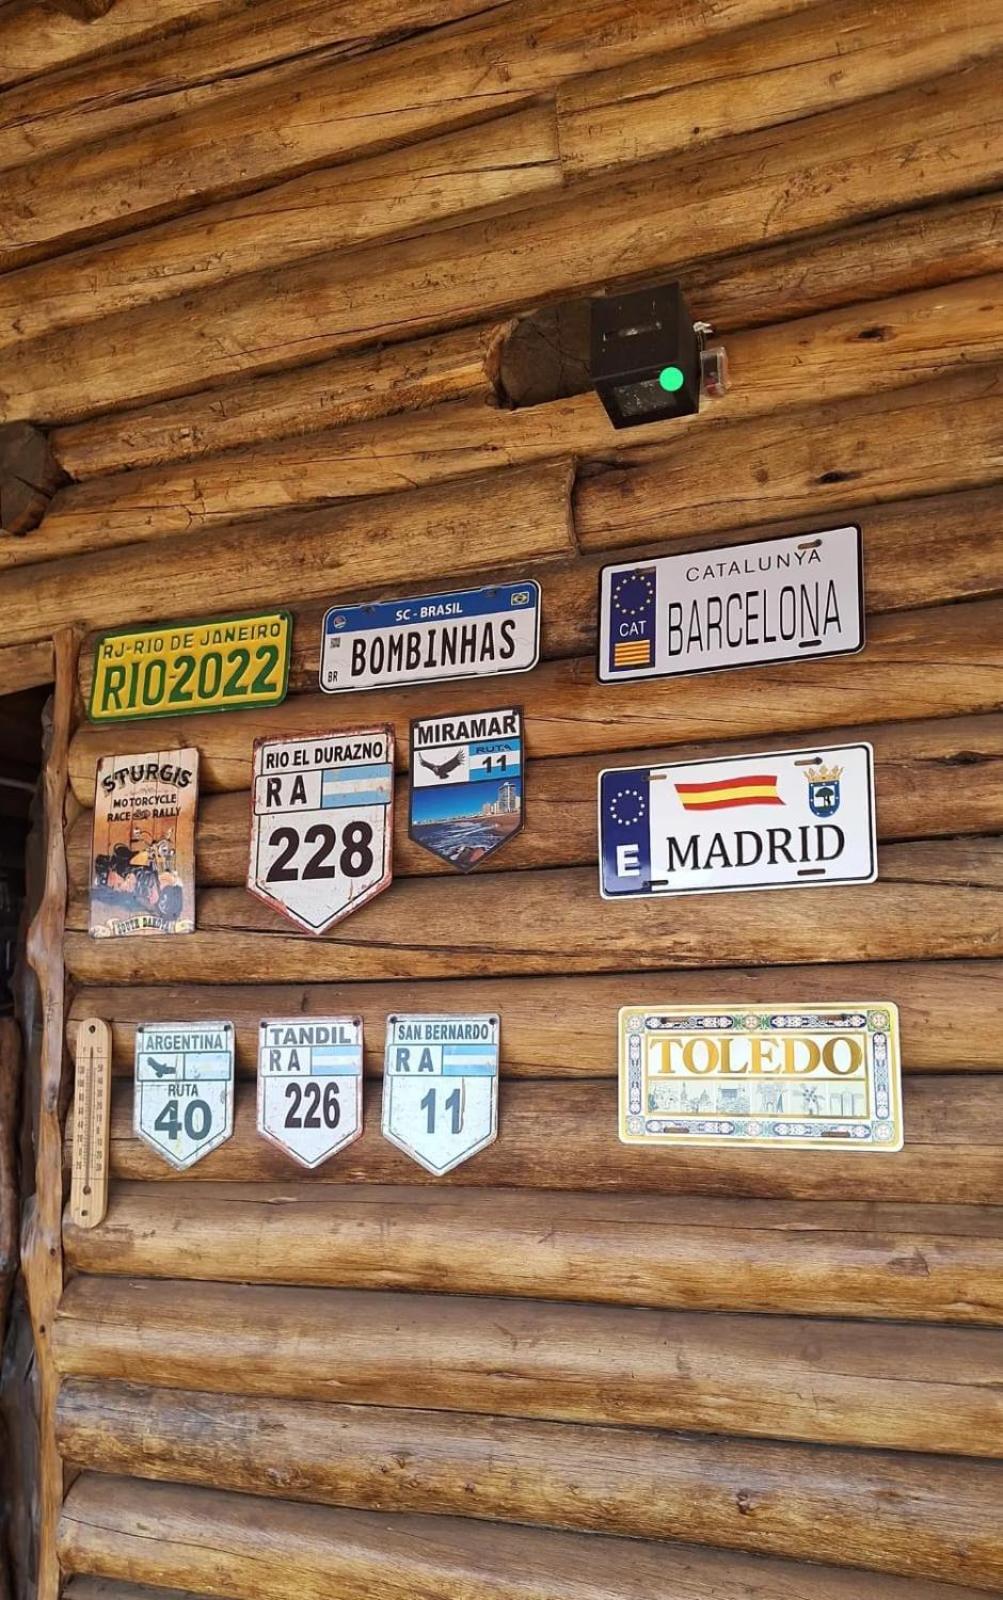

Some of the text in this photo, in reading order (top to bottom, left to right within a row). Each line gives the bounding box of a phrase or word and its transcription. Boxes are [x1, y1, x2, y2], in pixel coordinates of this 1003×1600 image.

[686, 549, 821, 582] CATALUNYA
[395, 609, 411, 622] SC
[420, 602, 463, 618] BRASIL
[668, 579, 842, 656] BARCELONA
[170, 633, 194, 650] DE
[200, 623, 281, 646] JANEIRO
[619, 620, 647, 637] CAT
[351, 619, 516, 677] BOMBINHAS
[327, 670, 338, 682] BR
[418, 715, 517, 745] MIRAMAR
[266, 741, 383, 769] RIO EL DURAZNO
[475, 744, 512, 755] RUTA
[482, 754, 507, 774] 11
[102, 763, 193, 794] STURGIS
[107, 811, 131, 822] RACE
[152, 807, 181, 819] RALLY
[113, 794, 177, 809] MOTORCYCLE
[266, 821, 374, 883] 228
[616, 844, 640, 878] E
[667, 824, 845, 872] MADRID
[146, 1035, 223, 1050] ARGENTINA
[270, 1027, 352, 1045] TANDIL
[398, 1024, 489, 1040] SAN BERNARDO
[650, 1037, 863, 1075] TOLEDO
[168, 1084, 198, 1097] RUTA
[284, 1081, 341, 1129] 226
[420, 1088, 461, 1134] 11
[154, 1099, 213, 1141] 40
